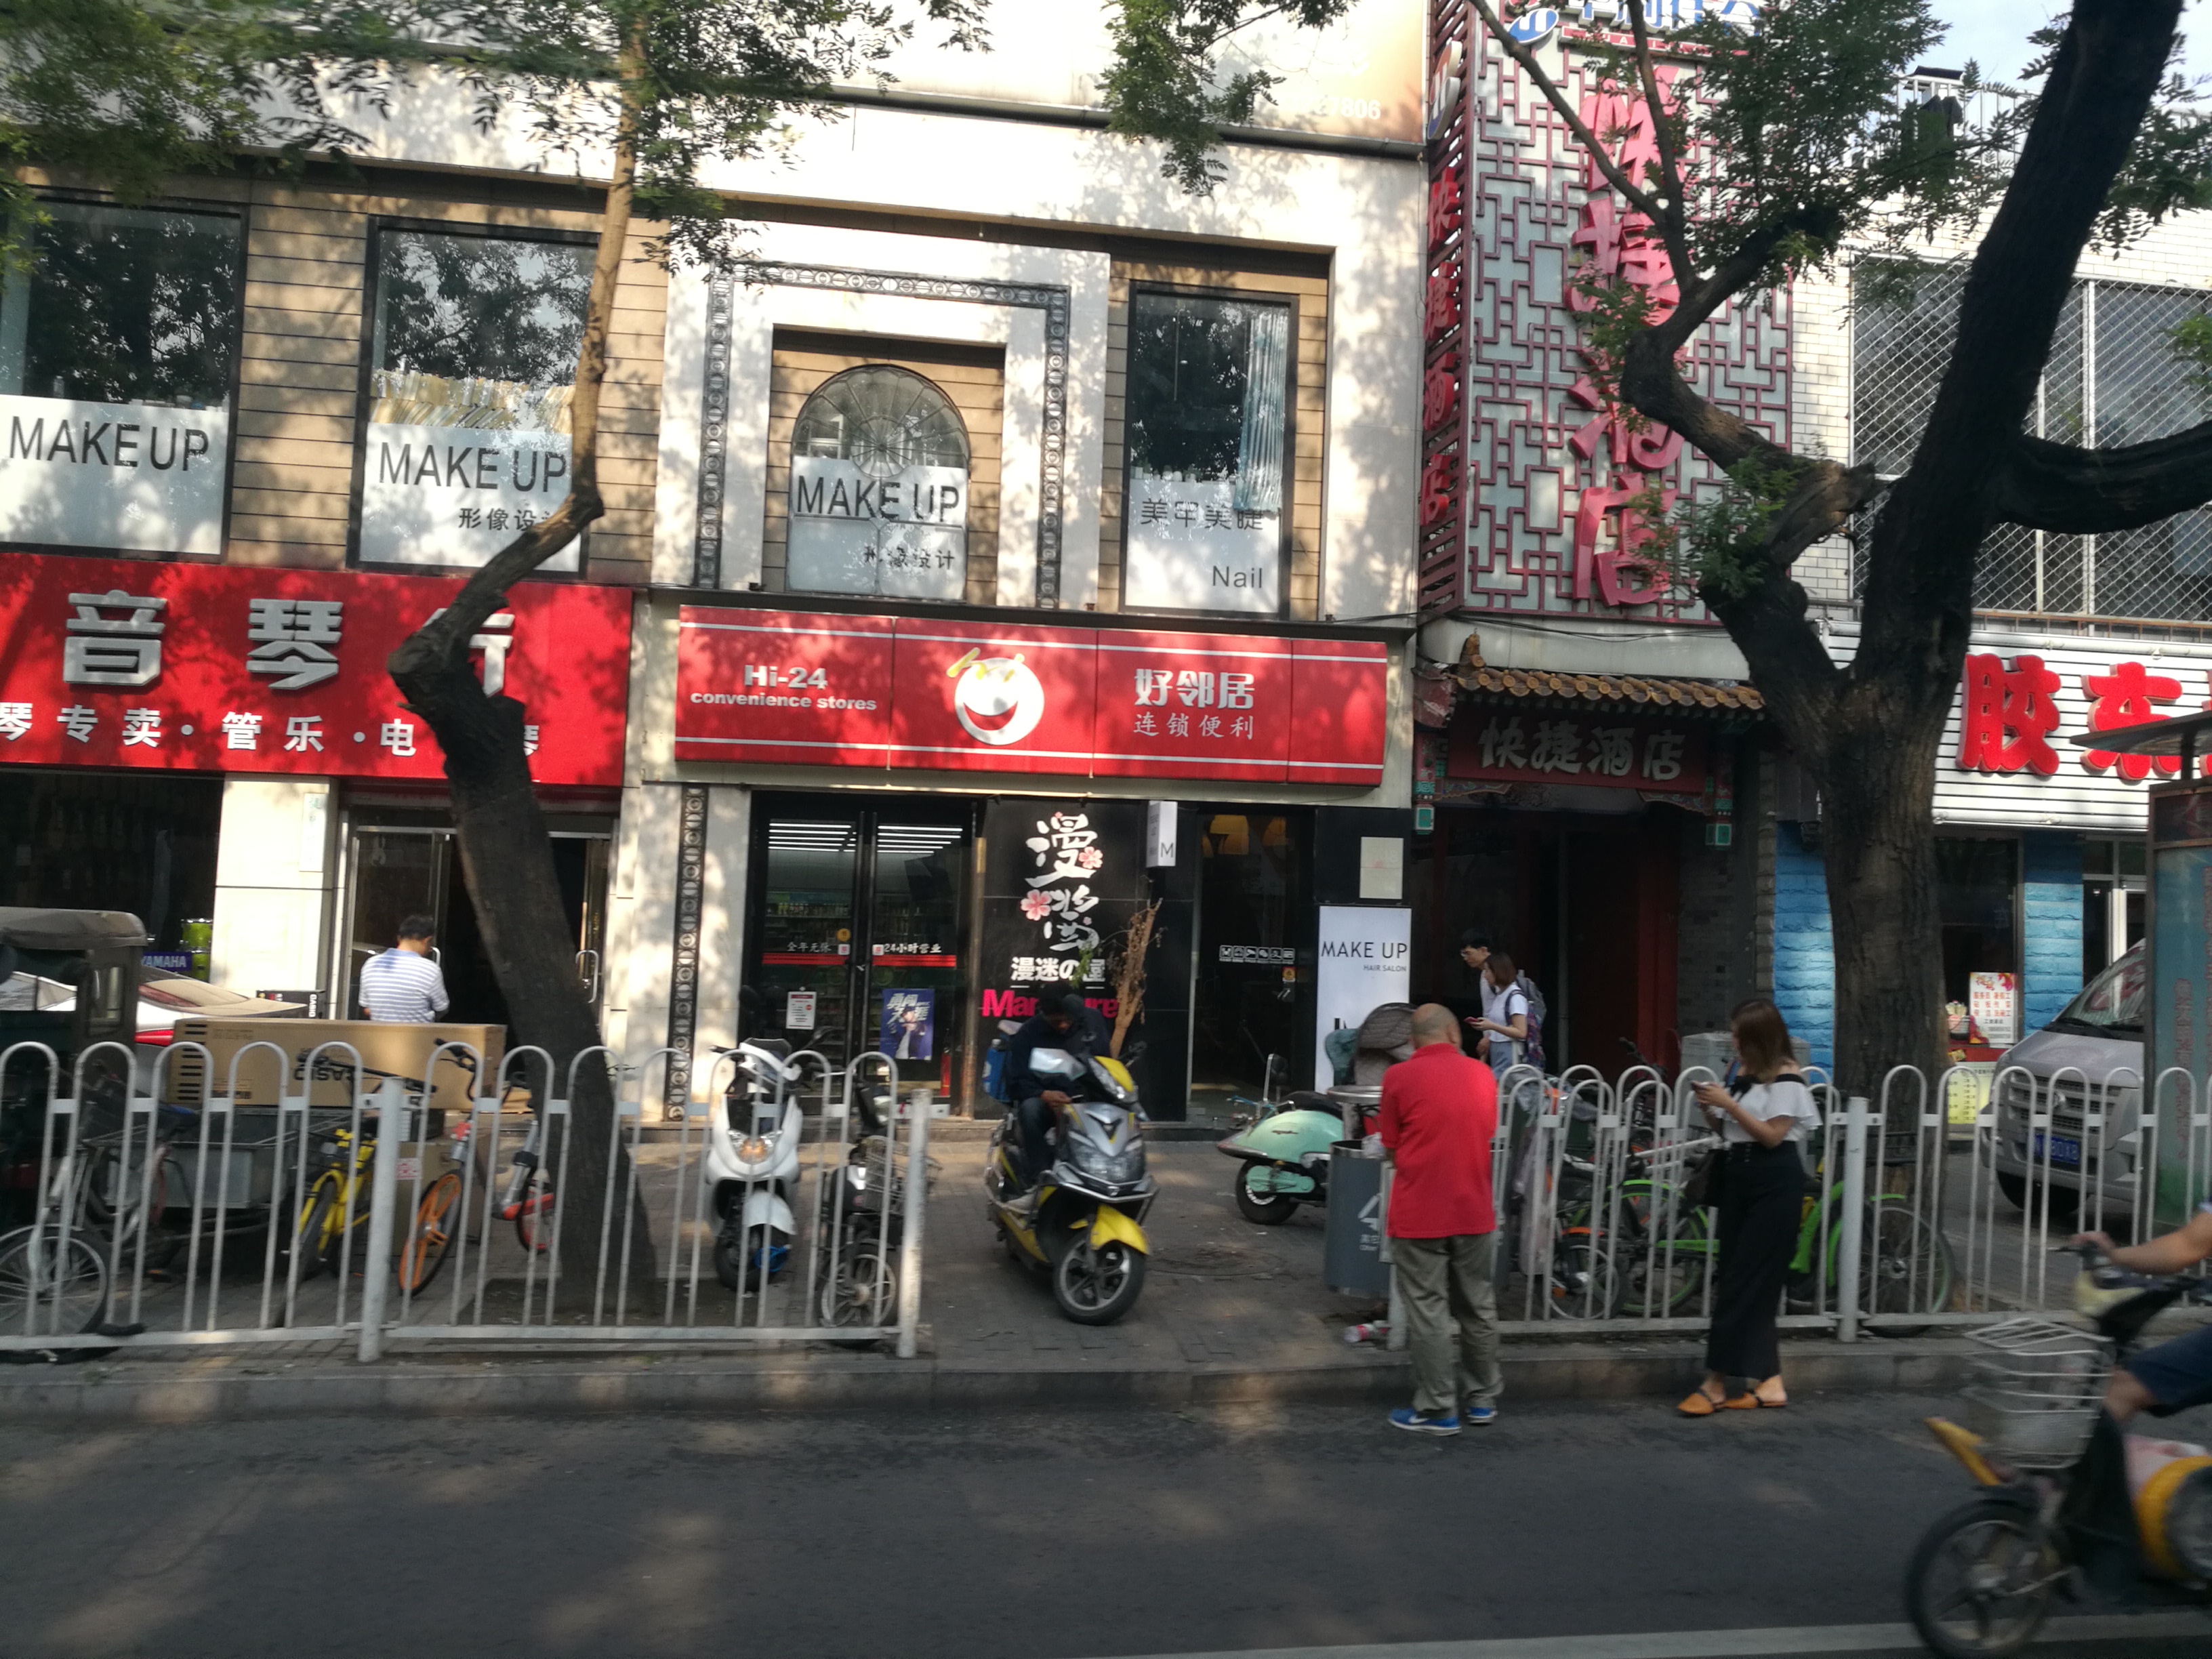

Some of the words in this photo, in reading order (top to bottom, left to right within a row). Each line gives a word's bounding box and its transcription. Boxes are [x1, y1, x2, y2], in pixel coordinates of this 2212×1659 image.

[9, 415, 140, 469] MAKE
[149, 427, 210, 472] UP
[380, 442, 500, 489] MAKE
[513, 449, 567, 493] UP
[796, 476, 900, 520] MAKE
[914, 482, 960, 526] UP
[458, 507, 550, 531] 形像设
[1212, 565, 1263, 589] Nail
[743, 663, 829, 691] Hi-24
[1134, 668, 1255, 710] 好邻居
[690, 690, 815, 710] convenience
[817, 693, 878, 712] stores
[1134, 712, 1254, 741] 连锁便利
[1956, 652, 2212, 781] 胶东
[1478, 715, 1686, 781] 快捷酒店
[1160, 842, 1174, 858] M
[1321, 941, 1374, 958] MAKE
[1382, 943, 1408, 959] UP
